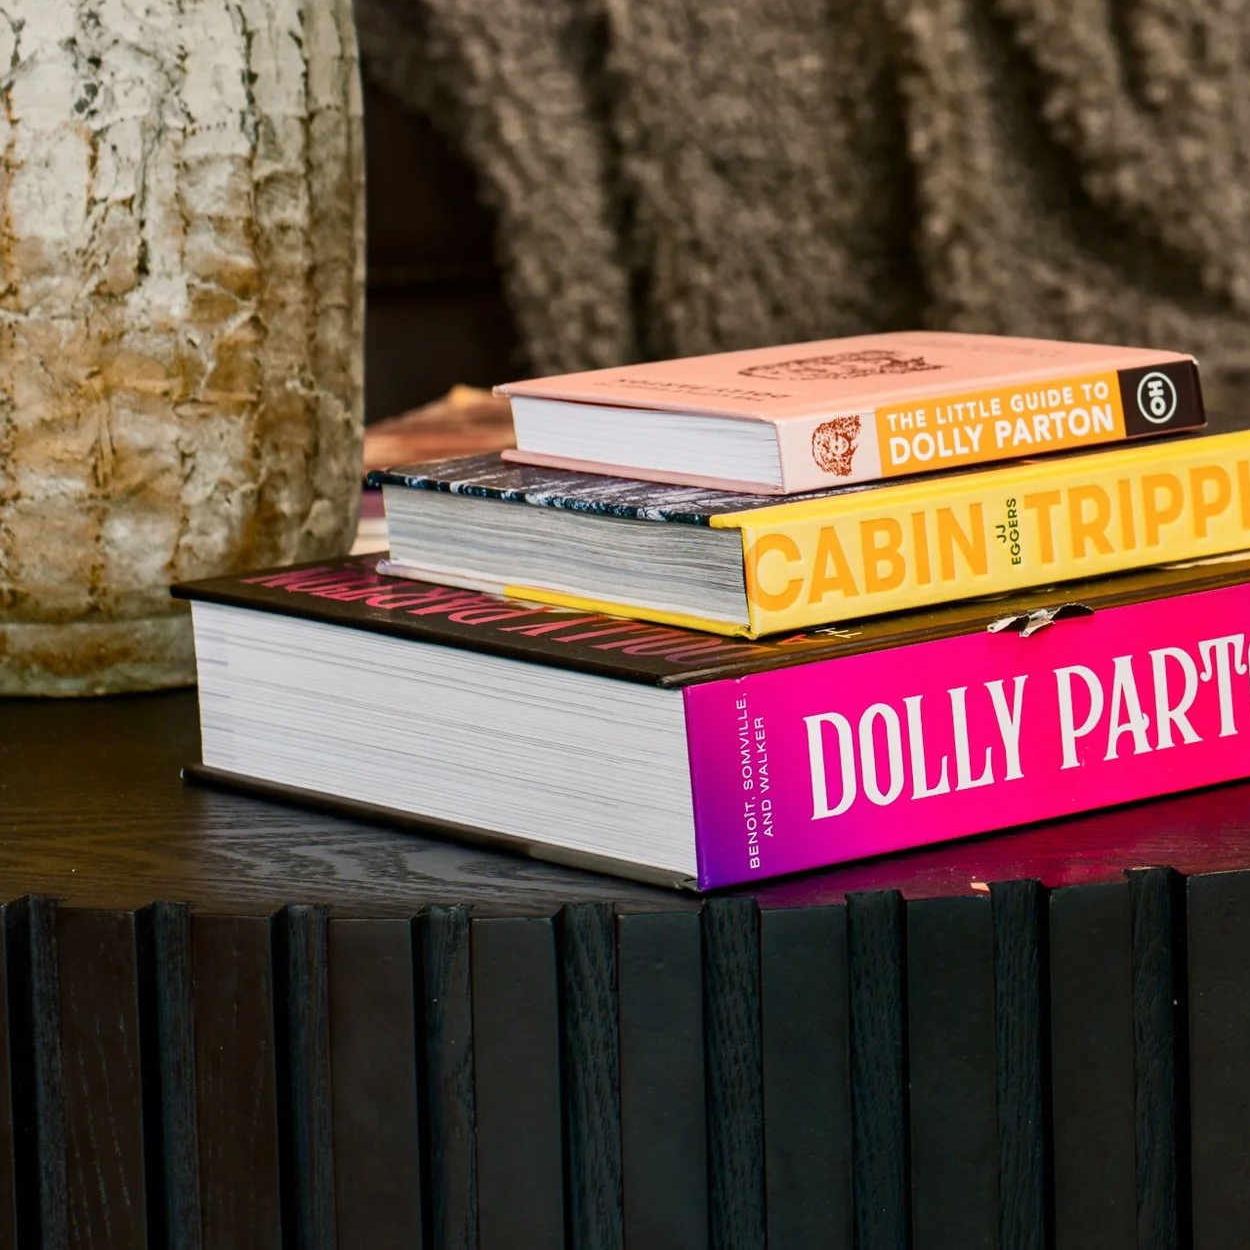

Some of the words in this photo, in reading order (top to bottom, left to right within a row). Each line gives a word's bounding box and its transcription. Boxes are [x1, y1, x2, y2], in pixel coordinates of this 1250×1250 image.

[886, 409, 927, 432] THE
[935, 397, 1003, 424] LITTLE
[1009, 386, 1075, 413] GUIDE
[1080, 380, 1109, 401] TO
[888, 423, 985, 466] DOLLY
[994, 404, 1115, 449] PARTON
[746, 501, 991, 613] CABIN
[995, 524, 1007, 544] JJ
[1006, 497, 1022, 566] EGGERS
[736, 692, 754, 791] SOMVILLE,
[754, 716, 770, 794] WALKER
[803, 673, 1029, 821] DOLLY
[761, 798, 774, 838] AND
